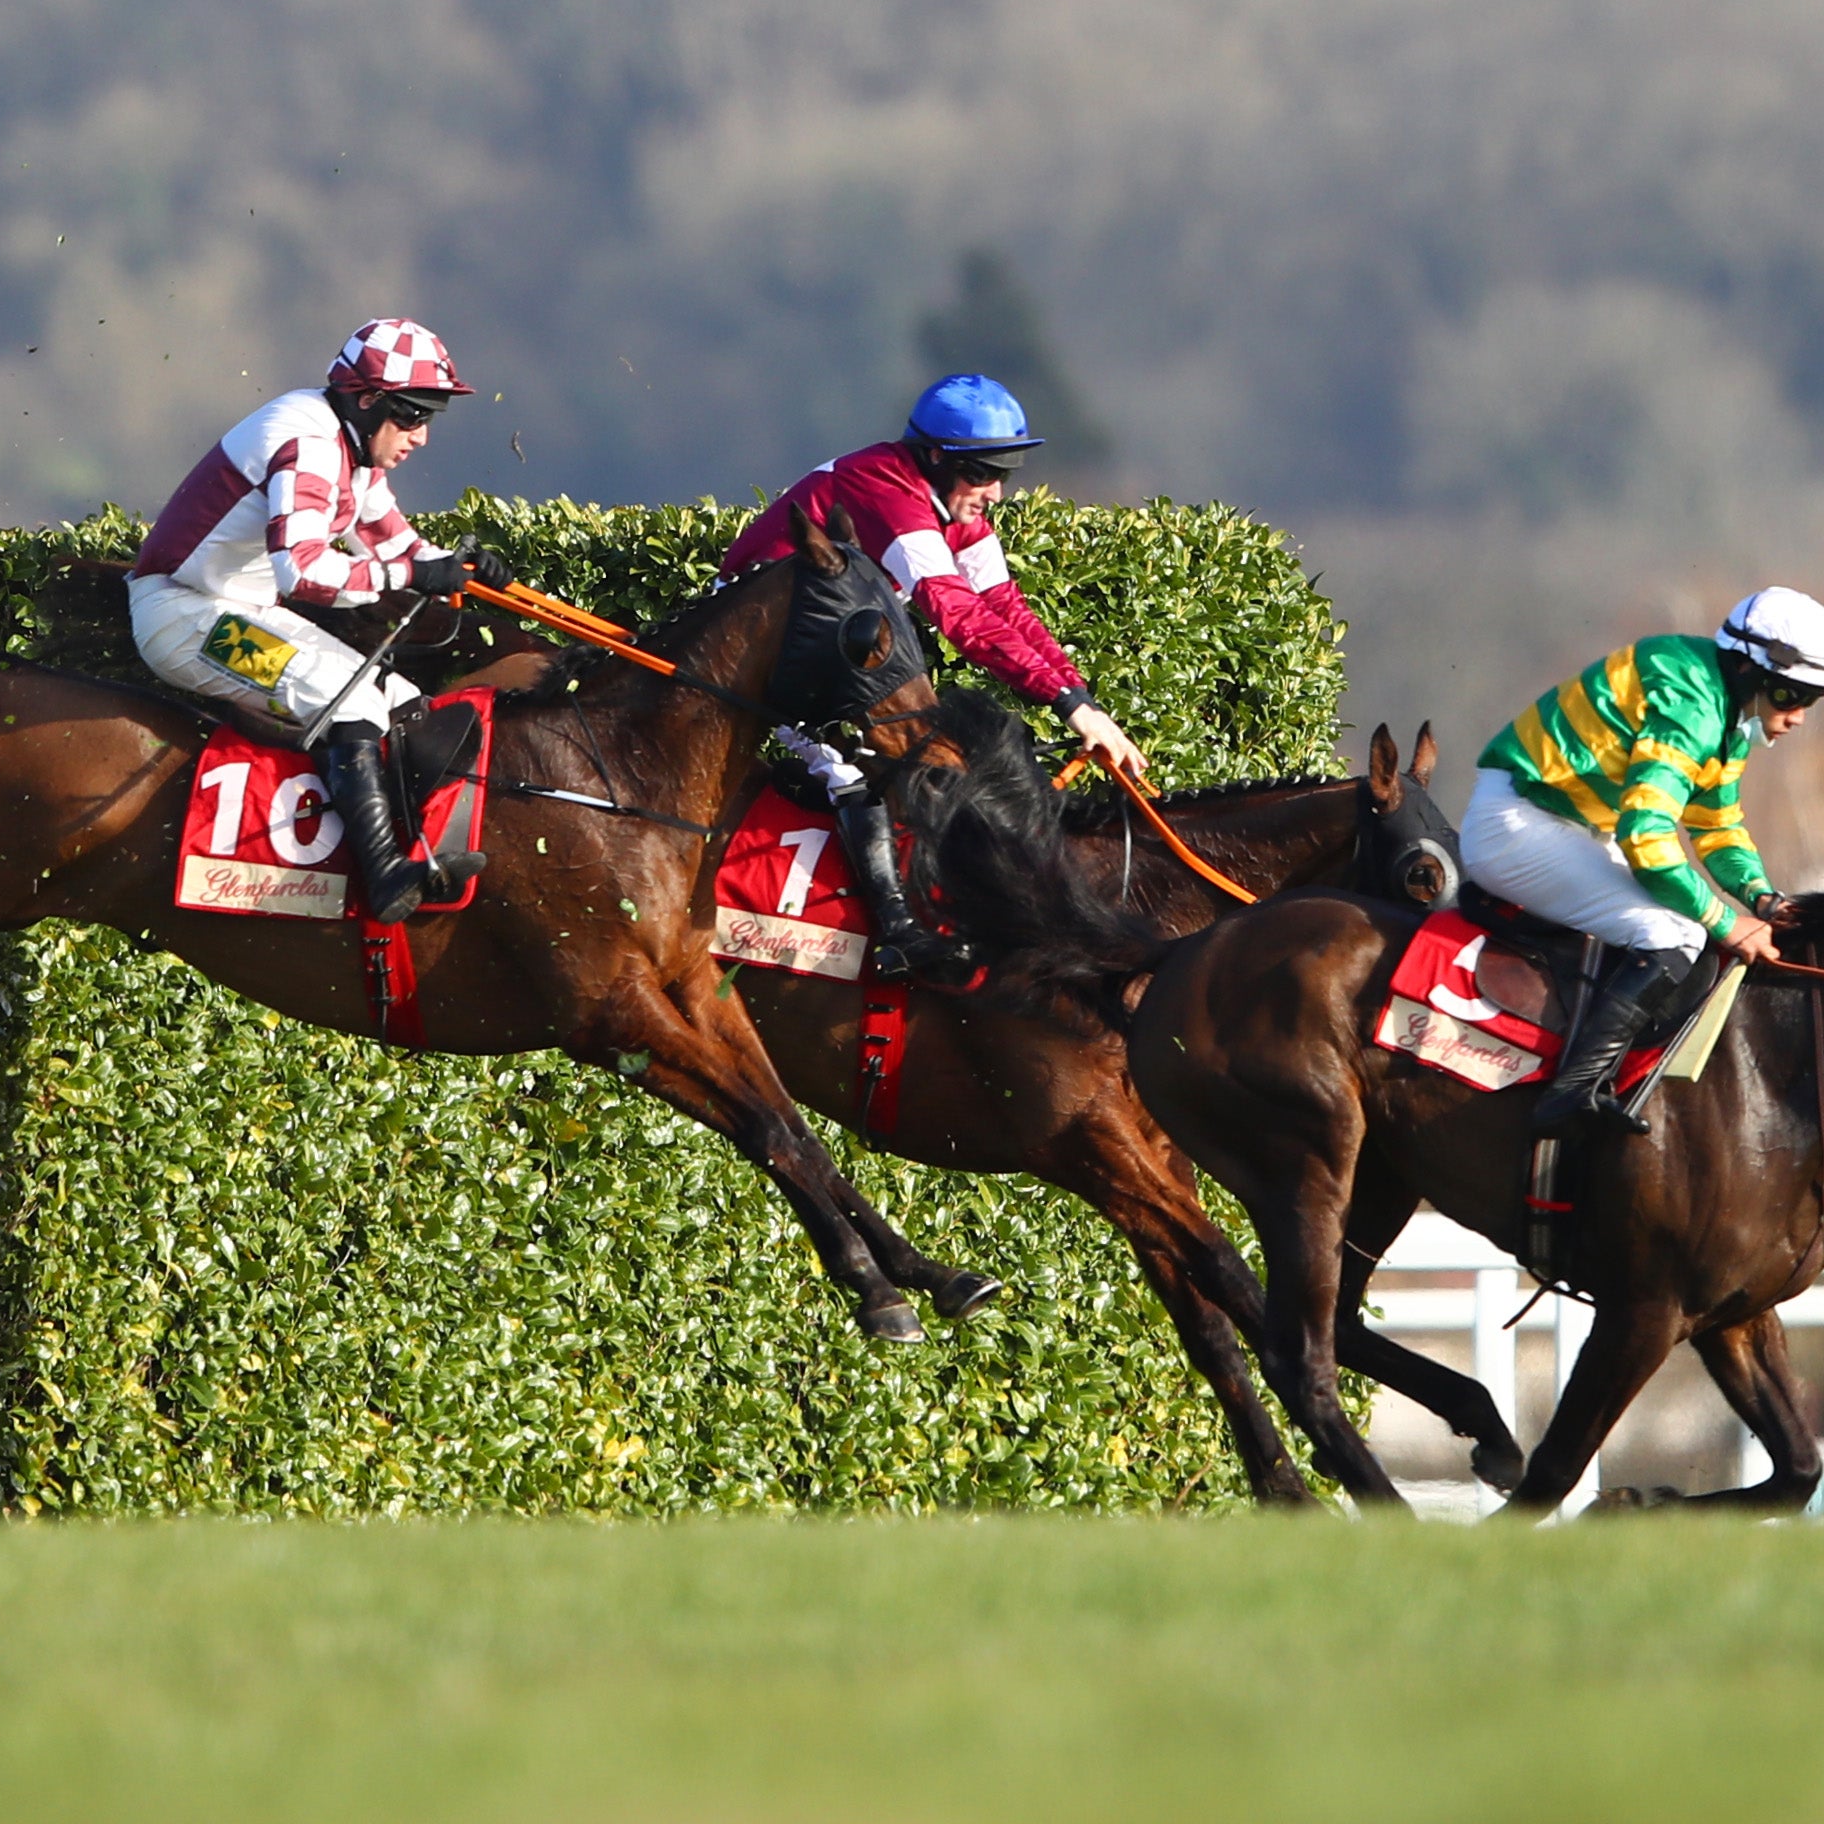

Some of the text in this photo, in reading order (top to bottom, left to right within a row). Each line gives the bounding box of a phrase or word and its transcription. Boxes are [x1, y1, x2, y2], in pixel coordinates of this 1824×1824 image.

[200, 762, 345, 866] 10
[200, 868, 329, 906] Glenfarclas
[777, 828, 831, 917] 1
[723, 920, 850, 960] Glenfarclas
[1398, 1012, 1524, 1073] Glenfarclas
